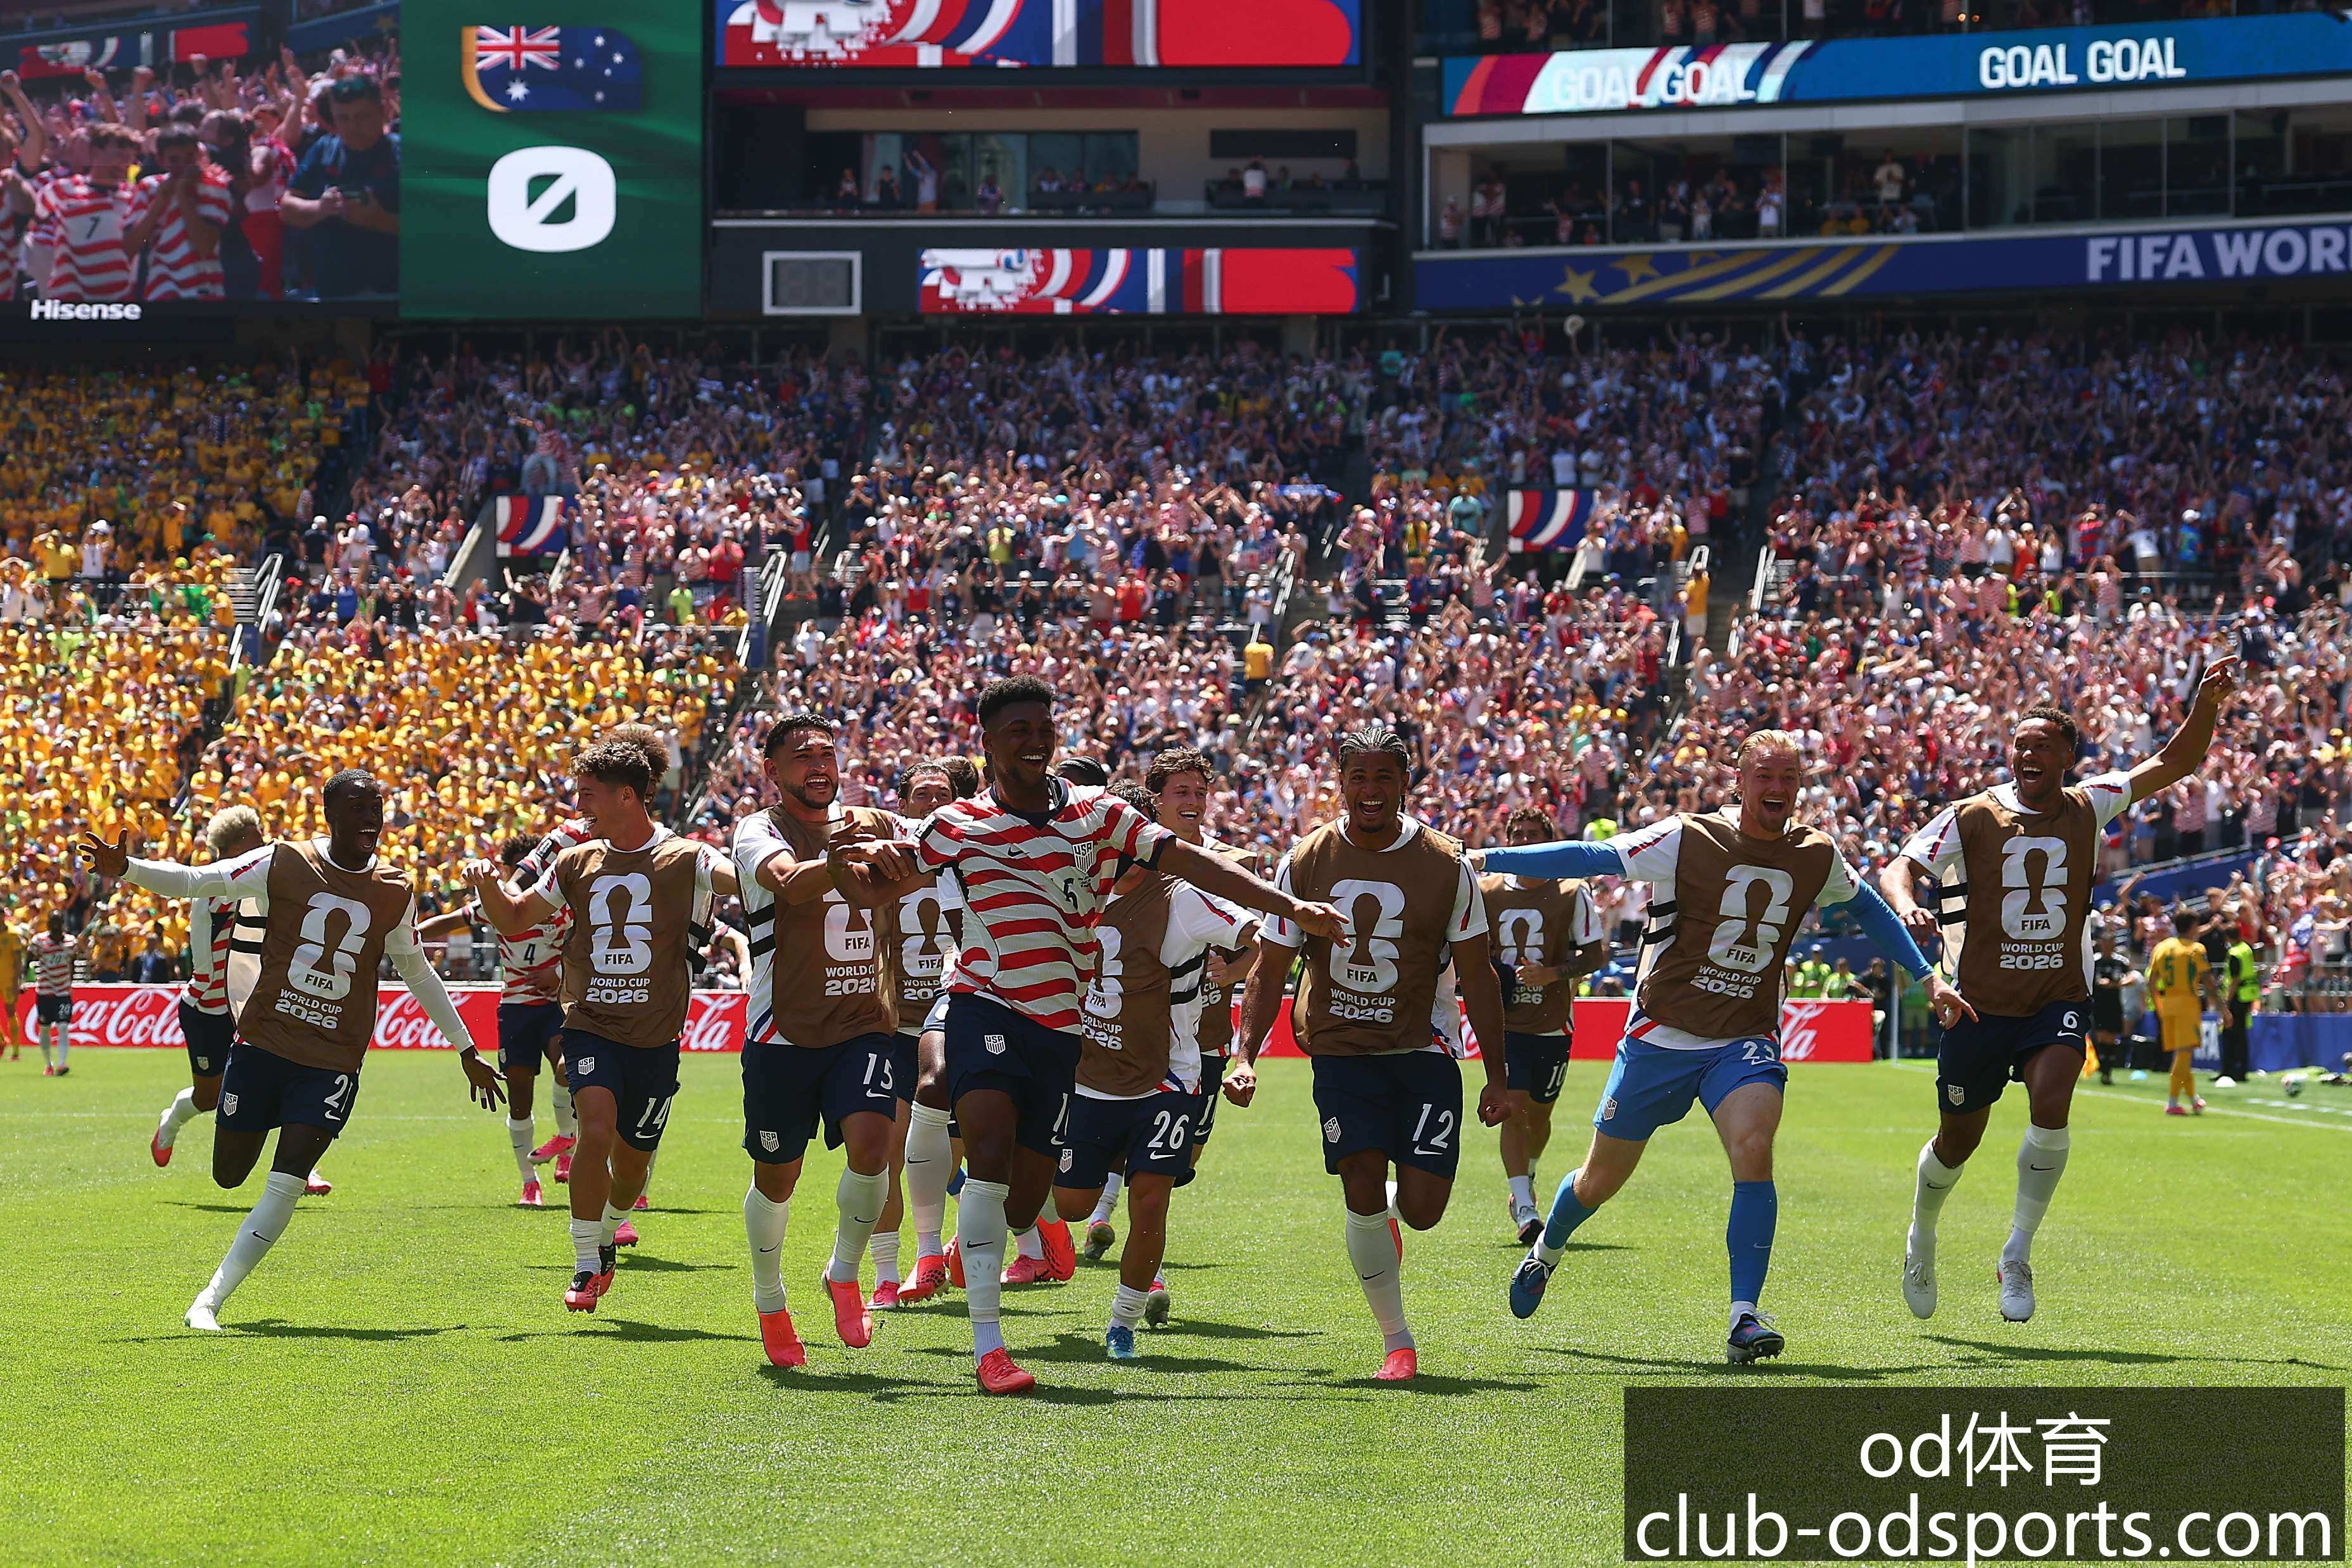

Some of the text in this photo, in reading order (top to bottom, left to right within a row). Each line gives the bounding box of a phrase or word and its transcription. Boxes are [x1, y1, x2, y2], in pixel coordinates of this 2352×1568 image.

[1979, 37, 2187, 89] GOAL GOAL
[1553, 61, 1756, 106] GOAL GOAL
[488, 146, 616, 253] 0
[2087, 226, 2352, 282] FIFA WOR
[31, 299, 141, 320] Hisense
[1074, 842, 1092, 856] USA
[2021, 920, 2051, 930] FIFA
[845, 937, 870, 950] FIFA
[2001, 942, 2064, 952] WORLD CUP
[524, 944, 535, 964] 4
[605, 954, 634, 964] FIFA
[1726, 949, 1756, 963] FIFA
[2000, 953, 2063, 970] 2026
[826, 966, 867, 977] WORLD
[1347, 968, 1378, 982] FIFA
[1698, 965, 1740, 982] WORLD
[305, 974, 334, 990] FIFA
[590, 977, 650, 987] WORLD CUP
[1690, 975, 1754, 999] 2026
[280, 989, 343, 1015] WORLD CUP
[586, 988, 648, 1003] 2026
[1331, 988, 1396, 1006] WORLD CUP
[275, 999, 338, 1029] 2026
[1329, 1001, 1393, 1023] 2026
[2063, 1011, 2080, 1028] 6
[1103, 1023, 1122, 1034] CUP
[986, 1035, 1002, 1044] USA
[1082, 1024, 1122, 1051] 026
[579, 1058, 593, 1066] USA
[863, 1053, 893, 1089] 15
[1546, 1062, 1567, 1089] 10
[1949, 1085, 1962, 1095] USA
[225, 1094, 237, 1104] USA
[636, 1096, 671, 1130] 14
[1148, 1111, 1189, 1149] 26
[1325, 1118, 1336, 1131] USA
[1412, 1103, 1453, 1149] 12
[761, 1132, 776, 1140] USA
